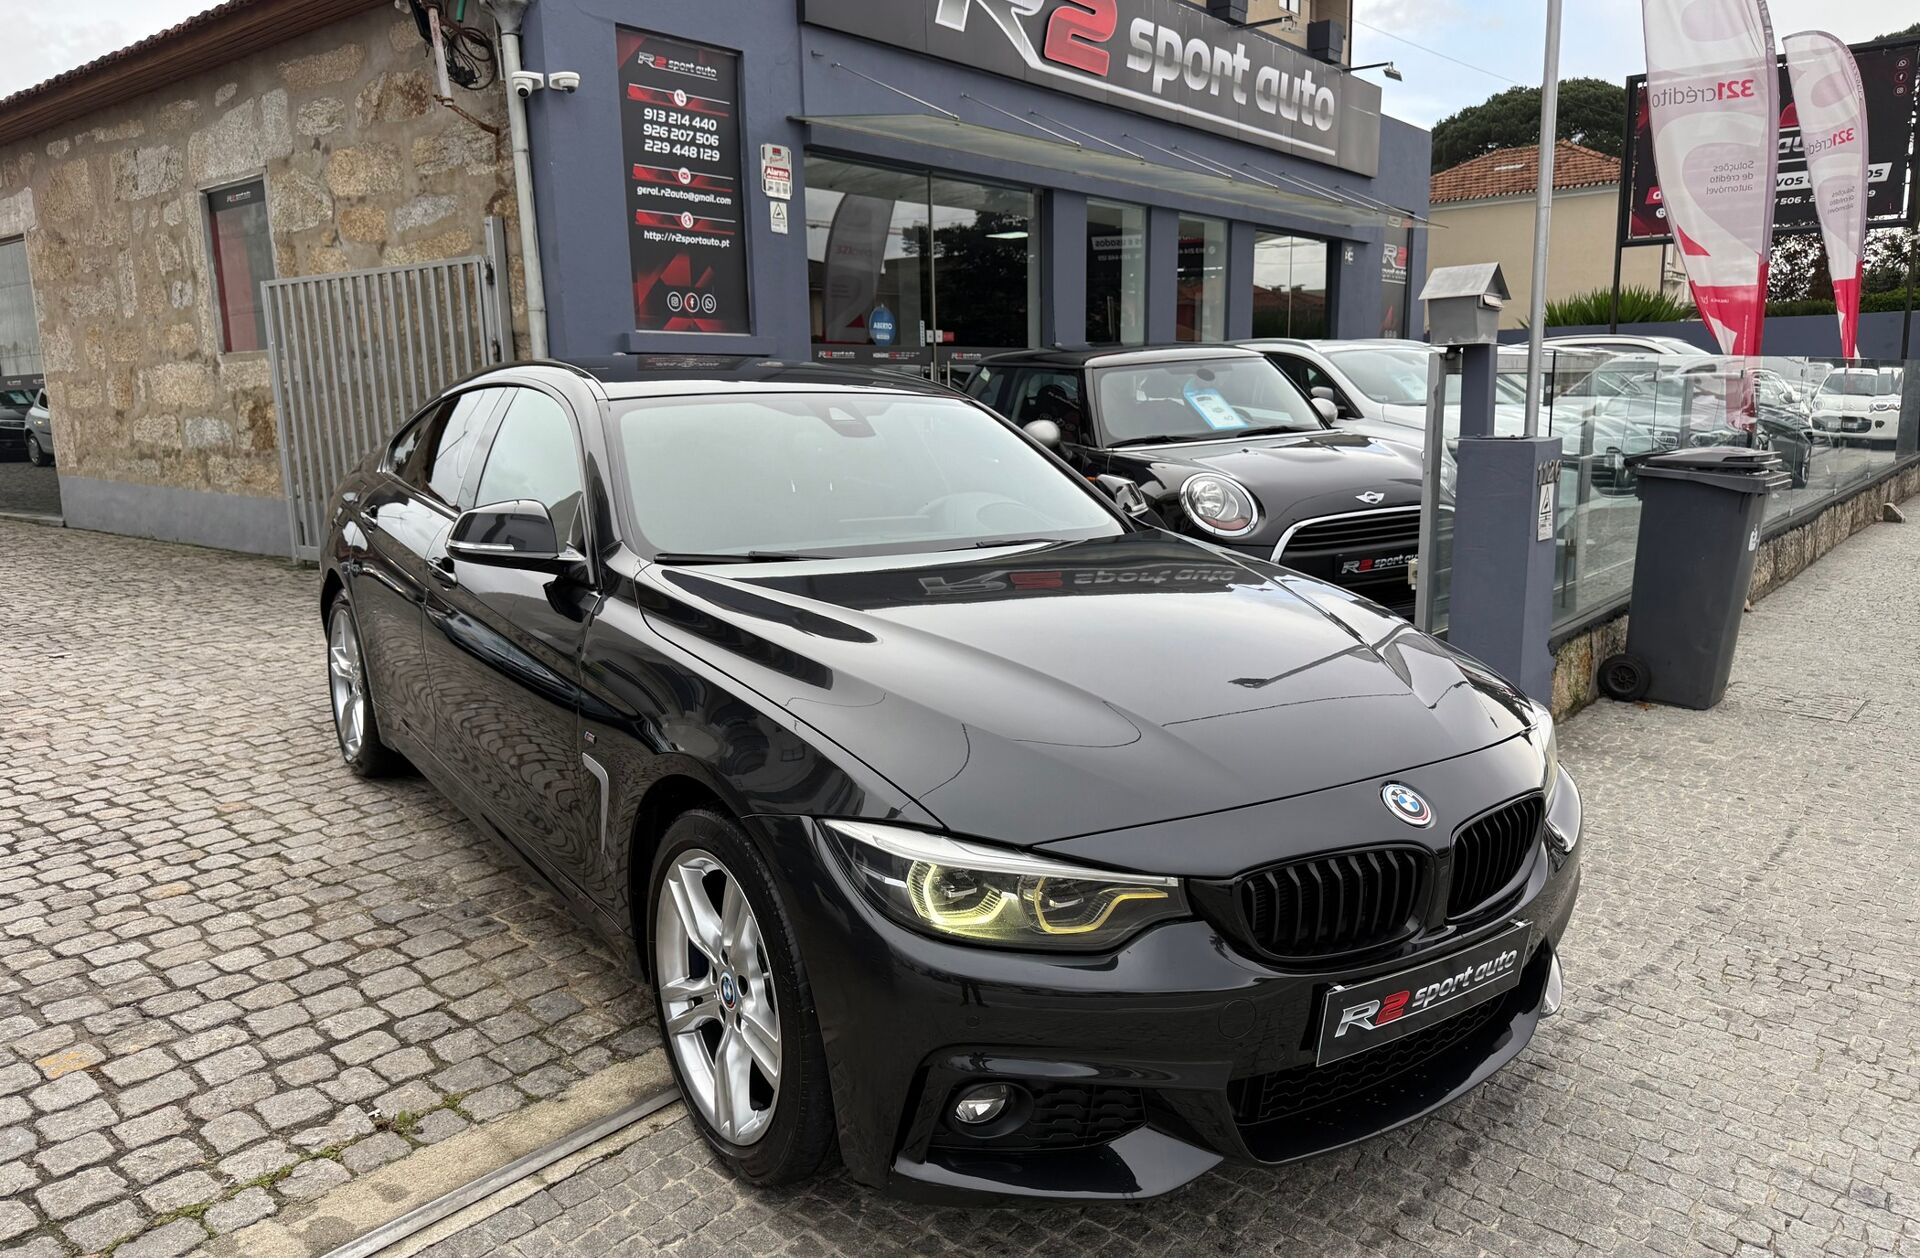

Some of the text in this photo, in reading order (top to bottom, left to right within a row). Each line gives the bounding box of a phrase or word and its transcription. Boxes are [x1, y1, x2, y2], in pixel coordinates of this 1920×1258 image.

[638, 51, 717, 77] R2 sport auto
[1126, 17, 1251, 106] sport
[1255, 65, 1335, 131] auto
[643, 108, 717, 131] 913 214 440
[643, 123, 719, 147] 926 207 506
[644, 139, 720, 162] 229 448 129
[637, 186, 732, 205] geral.r2auto@gmail.com
[1779, 196, 1802, 205] 506
[644, 230, 730, 248] http://r2sportauto.pt
[873, 321, 893, 330] ABERTO
[1341, 559, 1373, 574] R2
[1374, 554, 1404, 569] sport
[1334, 949, 1518, 1038] R2 sport auto
